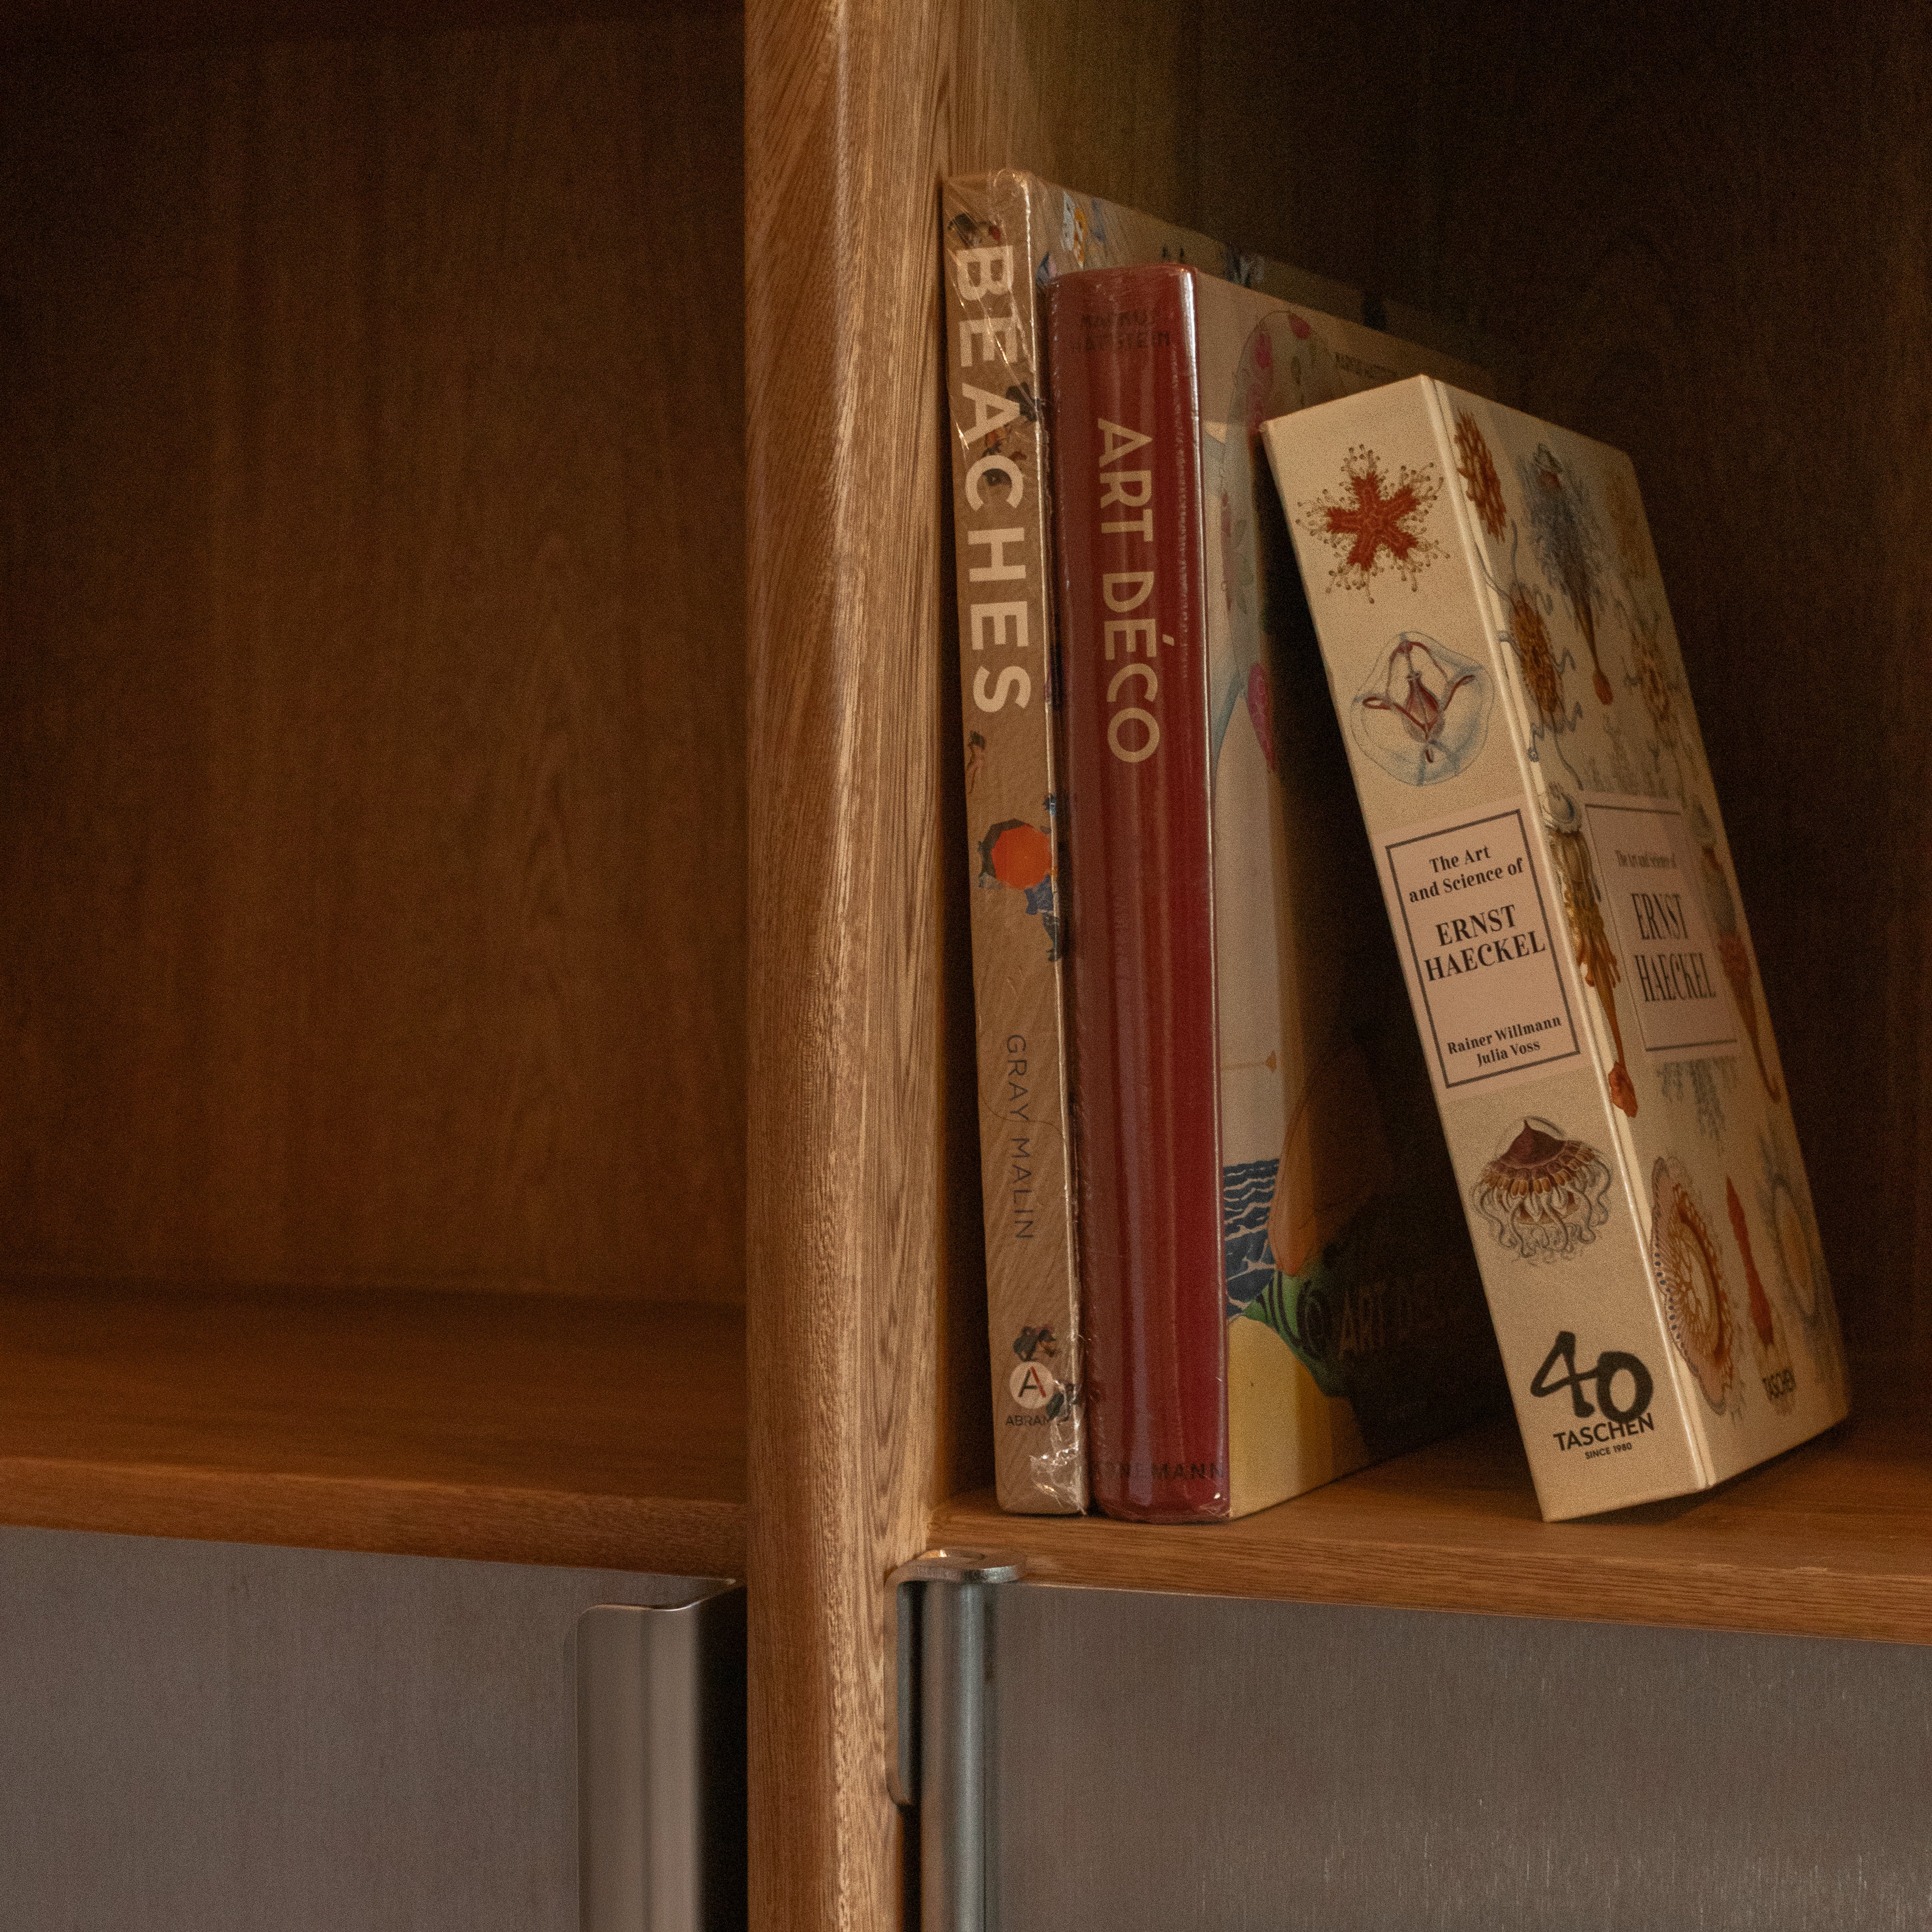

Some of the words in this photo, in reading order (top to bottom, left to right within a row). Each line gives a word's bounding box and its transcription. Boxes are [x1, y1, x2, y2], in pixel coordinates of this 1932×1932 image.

[957, 245, 1031, 713] BEACHES
[1097, 418, 1153, 542] ART
[1102, 571, 1175, 763] DÉCO
[1409, 881, 1440, 903] and
[1442, 866, 1504, 894] Science
[1507, 856, 1524, 876] of
[1429, 856, 1459, 874] The
[1463, 845, 1491, 865] Art
[1435, 904, 1516, 947] ERNST
[1630, 893, 1689, 940] ERNST
[1423, 930, 1547, 982] HAECKEL
[1634, 952, 1717, 1002] HAECKEL
[1447, 1031, 1493, 1055] Rainer
[1494, 1016, 1562, 1041] Willmann
[1476, 1049, 1508, 1067] Julia
[1510, 1040, 1541, 1056] Voss
[1006, 1034, 1029, 1121] GRAY
[1010, 1137, 1034, 1239] MALIN
[1018, 1366, 1047, 1398] A
[1529, 1331, 1654, 1423] 40
[1005, 1414, 1052, 1426] ABRAM
[1552, 1412, 1655, 1451] TASCHEN
[1584, 1447, 1611, 1460] SINCE
[1612, 1442, 1633, 1454] 1980
